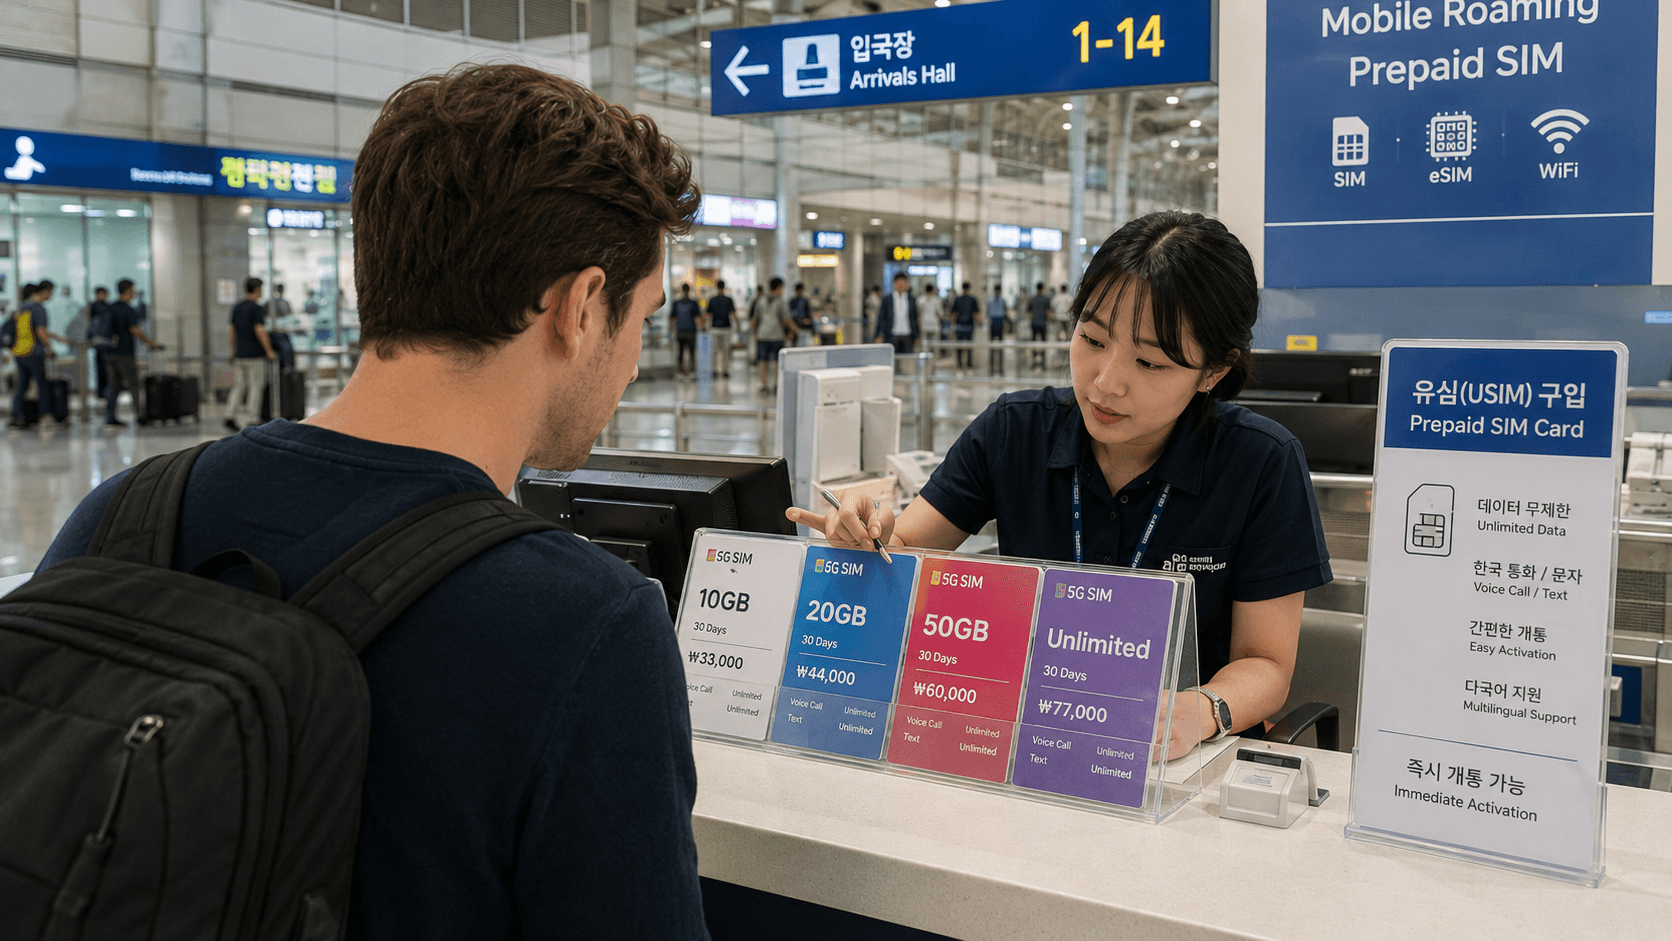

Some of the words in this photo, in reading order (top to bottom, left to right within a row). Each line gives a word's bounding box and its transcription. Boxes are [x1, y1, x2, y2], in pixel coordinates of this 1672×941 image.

[1322, 0, 1432, 37] Mobile
[1443, 0, 1600, 27] Roaming
[850, 30, 915, 63] 입국장
[1072, 15, 1164, 63] 1-14
[1350, 47, 1484, 90] Prepaid
[1495, 42, 1563, 76] SIM
[849, 67, 917, 90] Arrivals
[921, 63, 956, 84] Hall
[1334, 171, 1366, 188] SIM
[1429, 166, 1472, 184] eSIM
[1539, 162, 1578, 179] WiFi
[1413, 379, 1533, 408] 유심(USIM)
[1538, 382, 1585, 409] 구입
[1410, 414, 1484, 437] Prepaid
[1490, 417, 1528, 436] SIM
[1534, 419, 1584, 438] Card
[1478, 499, 1520, 516] 데이터
[1525, 502, 1571, 519] 무제한
[1477, 520, 1534, 534] Unlimited
[1538, 524, 1566, 537] Data
[732, 552, 753, 565] SIM
[841, 562, 863, 576] SIM
[1473, 560, 1502, 577] 한국
[1507, 563, 1537, 580] 통화
[1540, 566, 1548, 581] /
[1551, 567, 1583, 585] 문자
[941, 573, 959, 587] 5G
[960, 574, 983, 589] SIM
[1473, 581, 1505, 595] Voice
[1508, 585, 1530, 597] Call
[1533, 587, 1539, 599] /
[1542, 588, 1568, 601] Text
[699, 588, 750, 613] 10GB
[1067, 586, 1085, 600] 5G
[1086, 587, 1112, 603] SIM
[806, 600, 867, 627] 20GB
[693, 622, 705, 632] 30
[706, 624, 727, 635] Days
[923, 613, 989, 642] 50GB
[1469, 620, 1513, 639] 간편한
[1518, 625, 1547, 643] 개통
[802, 635, 814, 645] 30
[816, 637, 837, 650] Days
[1047, 627, 1151, 660] Unlimited
[1470, 641, 1496, 656] Easy
[1498, 645, 1556, 661] Activation
[688, 651, 743, 670] ₩33,000
[918, 650, 932, 661] 30
[934, 652, 957, 665] Days
[797, 665, 855, 685] ₩44,000
[1043, 665, 1058, 677] 30
[1061, 667, 1087, 681] Days
[686, 683, 699, 693] oice
[913, 682, 976, 704] ₩60,000
[1465, 679, 1508, 699] 다국어
[1512, 685, 1542, 704] 지원
[790, 698, 809, 709] Voice
[1038, 699, 1107, 723] ₩77,000
[1463, 700, 1527, 718] Multilingual
[1530, 709, 1577, 725] Support
[788, 714, 803, 724] Text
[907, 716, 927, 728] Voice
[928, 718, 943, 729] Call
[904, 732, 920, 743] Text
[1032, 735, 1054, 748] Voice
[1056, 739, 1072, 750] Call
[1030, 753, 1048, 765] Text
[1091, 764, 1132, 780] Unlimited
[1406, 758, 1441, 782] 즉시
[1447, 765, 1483, 789] 개통
[1489, 773, 1526, 796] 가능
[1394, 784, 1464, 808] Immediate
[1467, 798, 1537, 822] Activation
